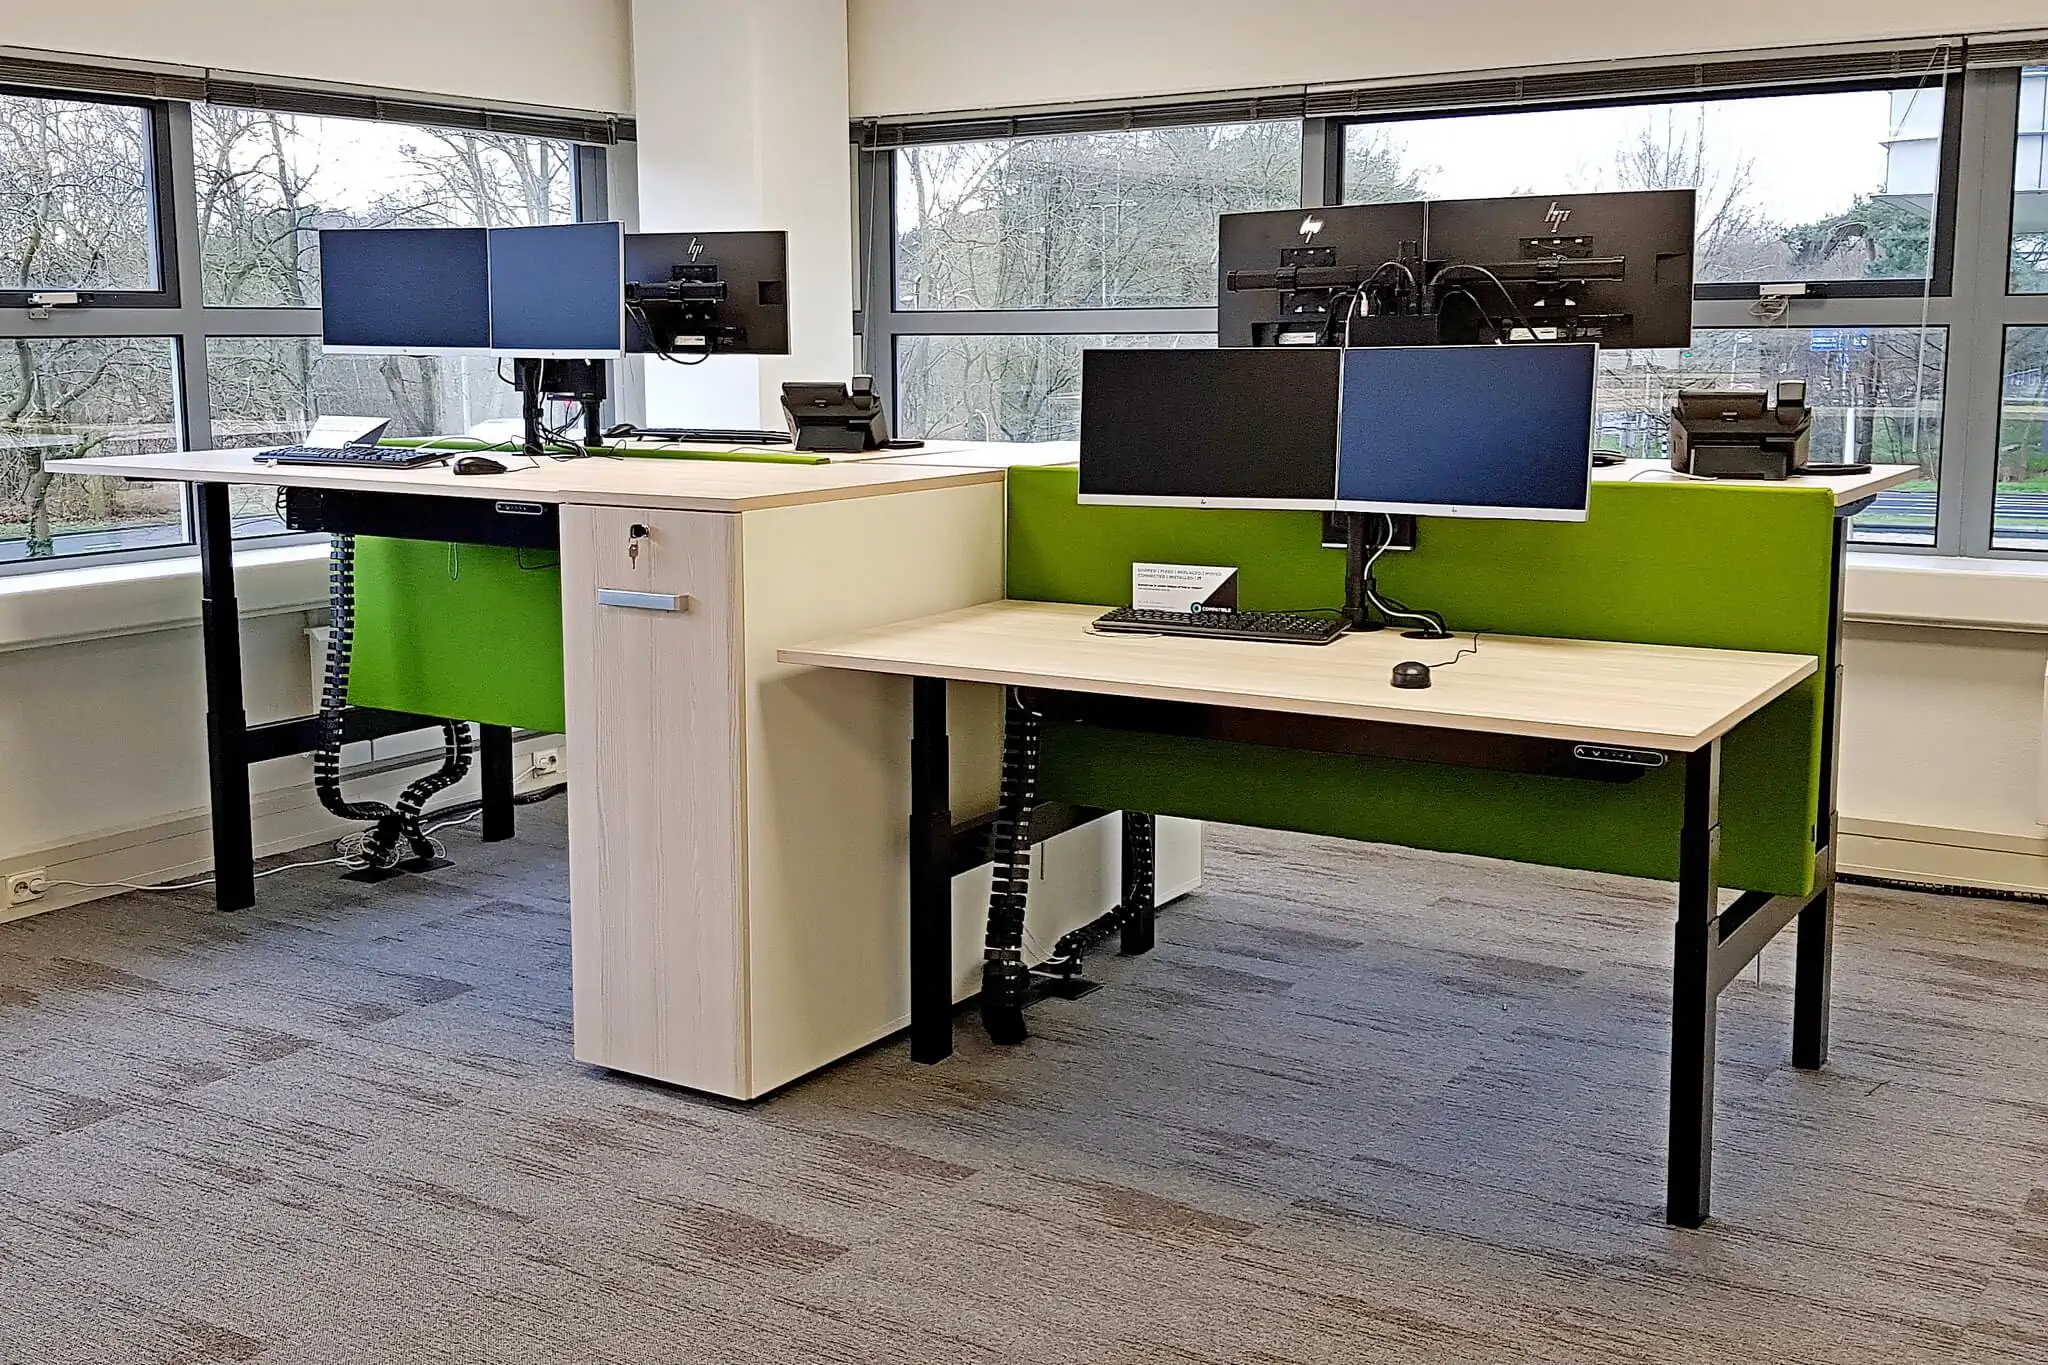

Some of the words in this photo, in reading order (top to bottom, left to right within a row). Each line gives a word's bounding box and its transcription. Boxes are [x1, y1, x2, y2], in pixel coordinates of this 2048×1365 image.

[1299, 214, 1324, 244] hp
[1542, 202, 1571, 233] hp
[687, 237, 704, 262] hp
